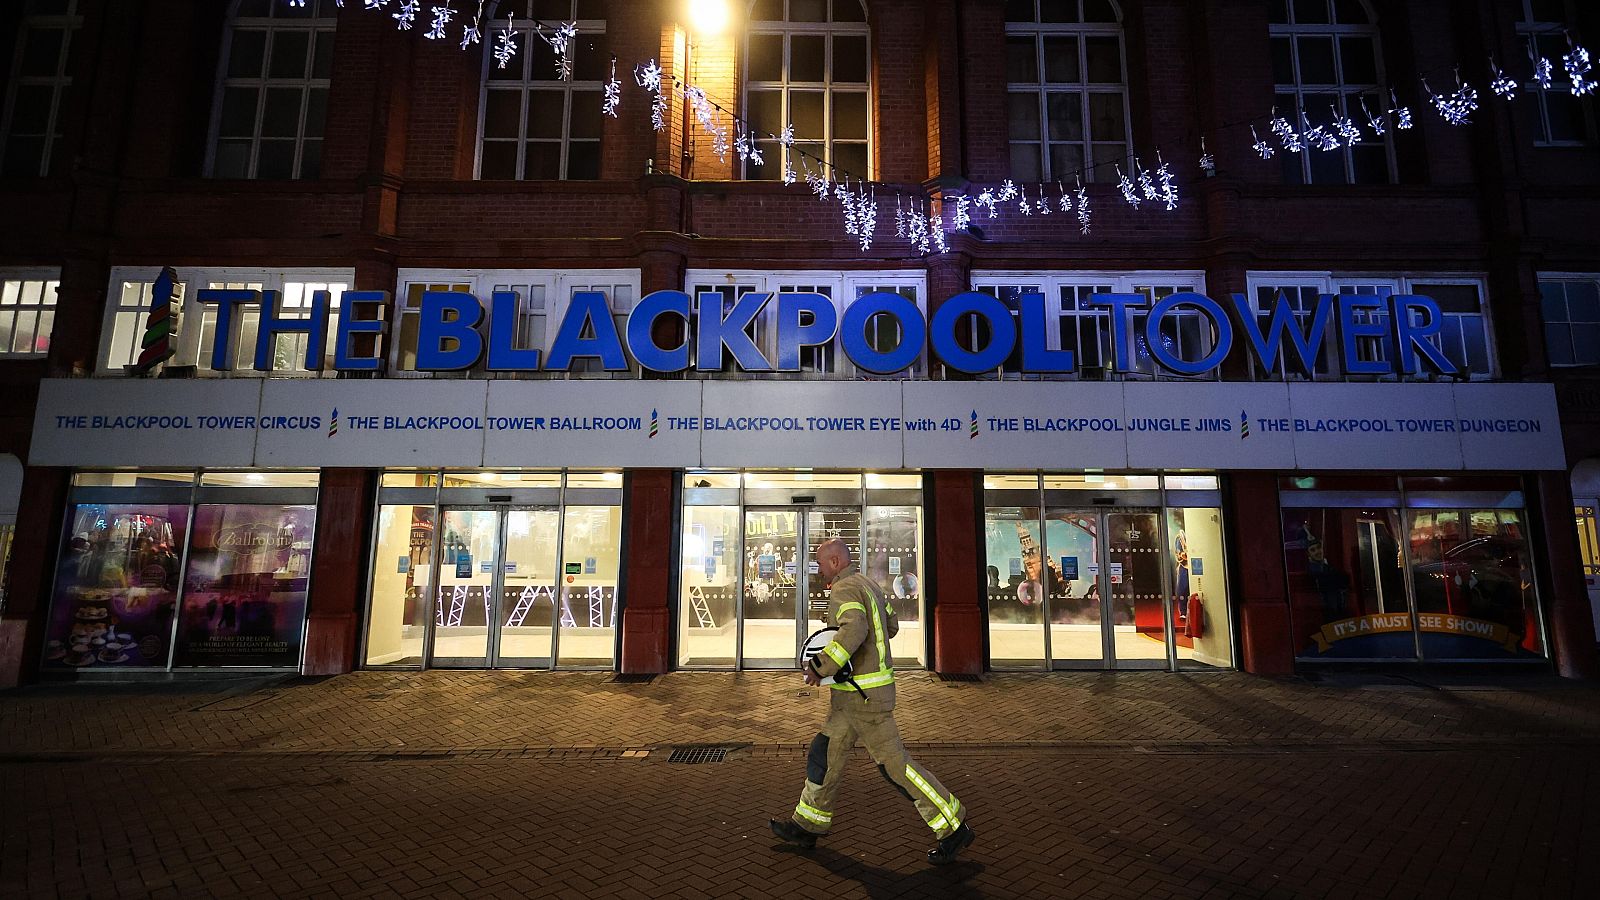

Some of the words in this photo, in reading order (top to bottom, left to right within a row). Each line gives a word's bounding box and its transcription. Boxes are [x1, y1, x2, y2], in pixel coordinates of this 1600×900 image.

[197, 288, 390, 372] THE
[414, 289, 1075, 375] BLACKPOOL
[1088, 291, 1463, 378] TOWER
[56, 416, 88, 429] THE
[91, 416, 193, 429] BLACKPOOL
[198, 416, 256, 430] TOWER
[259, 416, 321, 430] CIRCUS
[347, 416, 379, 430] THE
[383, 416, 484, 430] BLACKPOOL
[487, 417, 546, 431] TOWER
[549, 417, 642, 431] BALLROOM
[667, 417, 699, 431] THE
[703, 417, 804, 431] BLACKPOOL
[806, 417, 866, 431] TOWER
[869, 418, 901, 431] EYE
[905, 418, 937, 431] with
[940, 418, 961, 431] 4D
[987, 418, 1019, 431] THE
[1023, 418, 1124, 432] BLACKPOOL
[1127, 418, 1191, 432] JUNGLE
[1194, 418, 1232, 432] JIMS
[1257, 418, 1290, 432] THE
[1294, 419, 1394, 432] BLACKPOOL
[1396, 419, 1456, 432] TOWER
[1459, 419, 1542, 433] DUNGEON
[221, 531, 289, 546] Ballroom
[1334, 621, 1357, 636] IT'S
[1359, 620, 1370, 631] A
[1372, 616, 1409, 629] MUST
[1419, 615, 1442, 628] SEE
[1446, 617, 1494, 636] SHOW!
